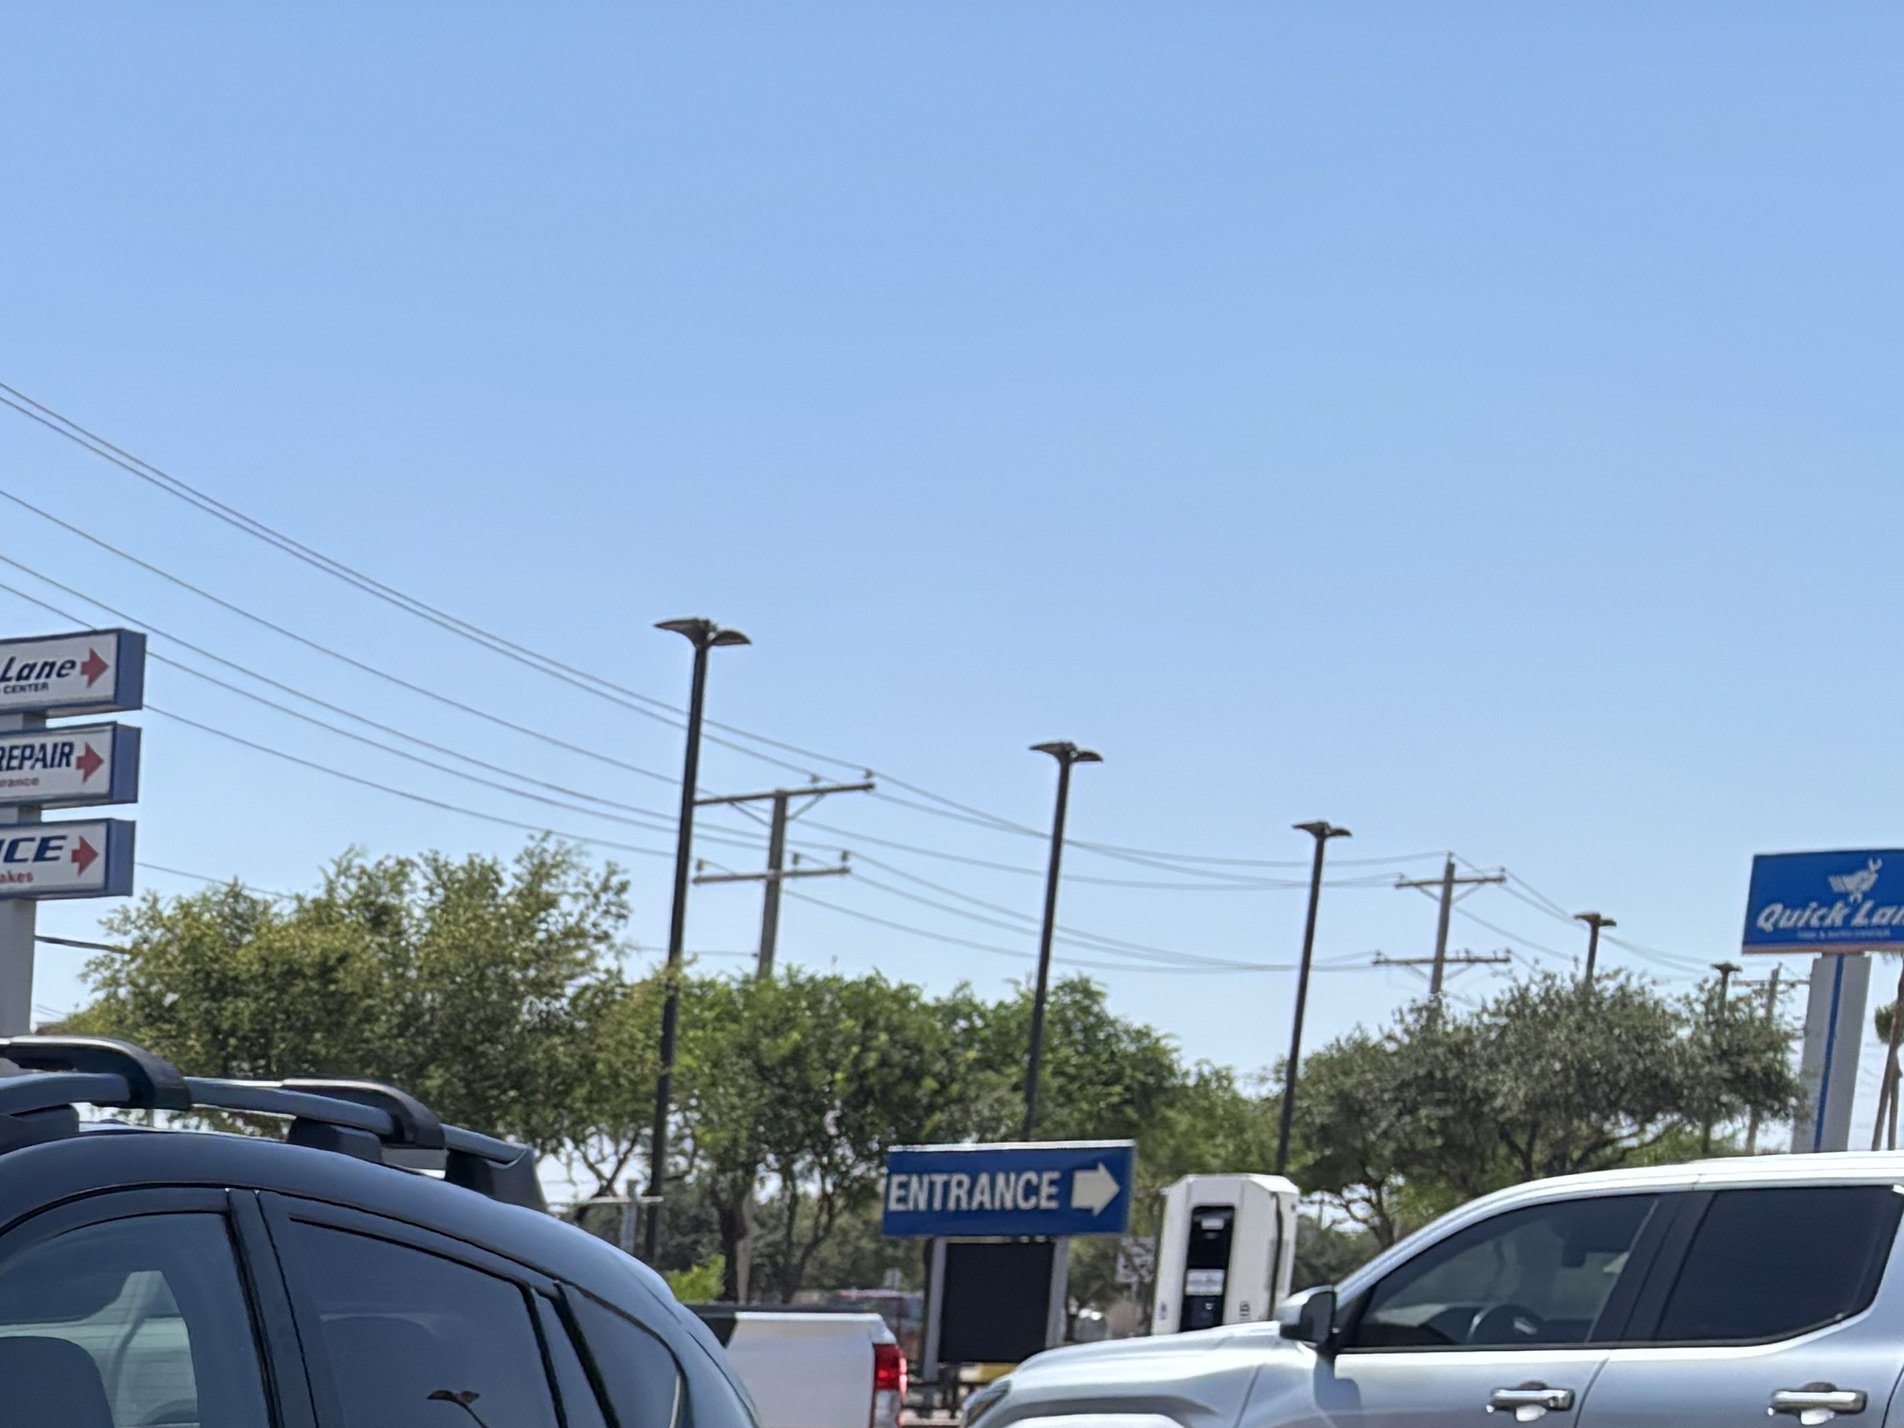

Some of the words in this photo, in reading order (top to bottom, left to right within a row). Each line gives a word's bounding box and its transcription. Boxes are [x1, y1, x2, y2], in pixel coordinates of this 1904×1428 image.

[3, 682, 49, 694] CENTER
[1757, 901, 1852, 933] Quick
[888, 1170, 1061, 1213] ENTRANCE
